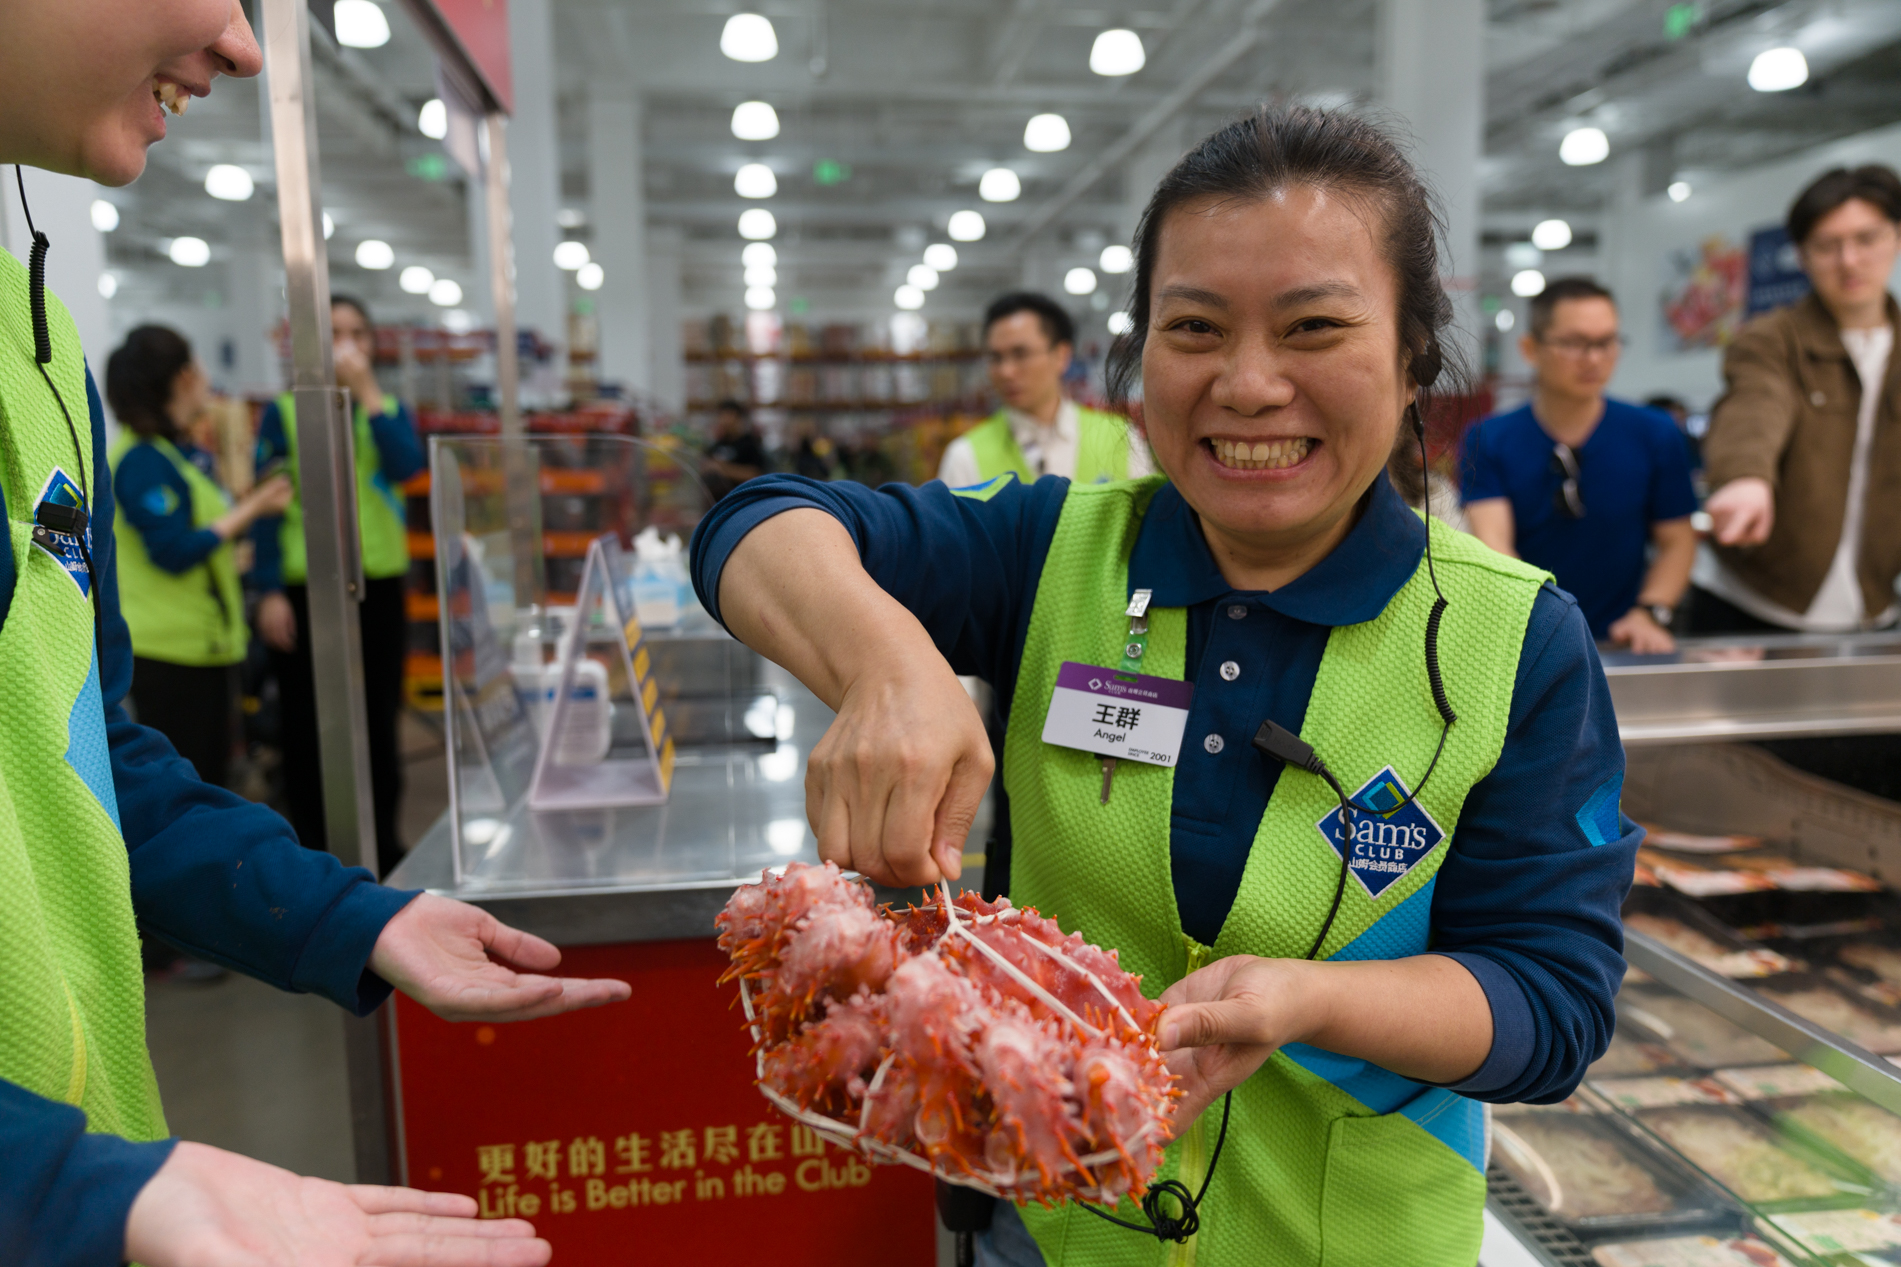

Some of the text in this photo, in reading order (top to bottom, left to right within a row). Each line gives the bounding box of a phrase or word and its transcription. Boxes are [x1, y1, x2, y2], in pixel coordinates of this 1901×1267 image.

[1092, 703, 1141, 730] 王群
[1094, 728, 1126, 743] Angel
[1150, 752, 1171, 763] 2001
[1336, 807, 1426, 850] Sam's
[1355, 844, 1404, 860] CLUB
[479, 1155, 871, 1219] Life is Better in the Club
